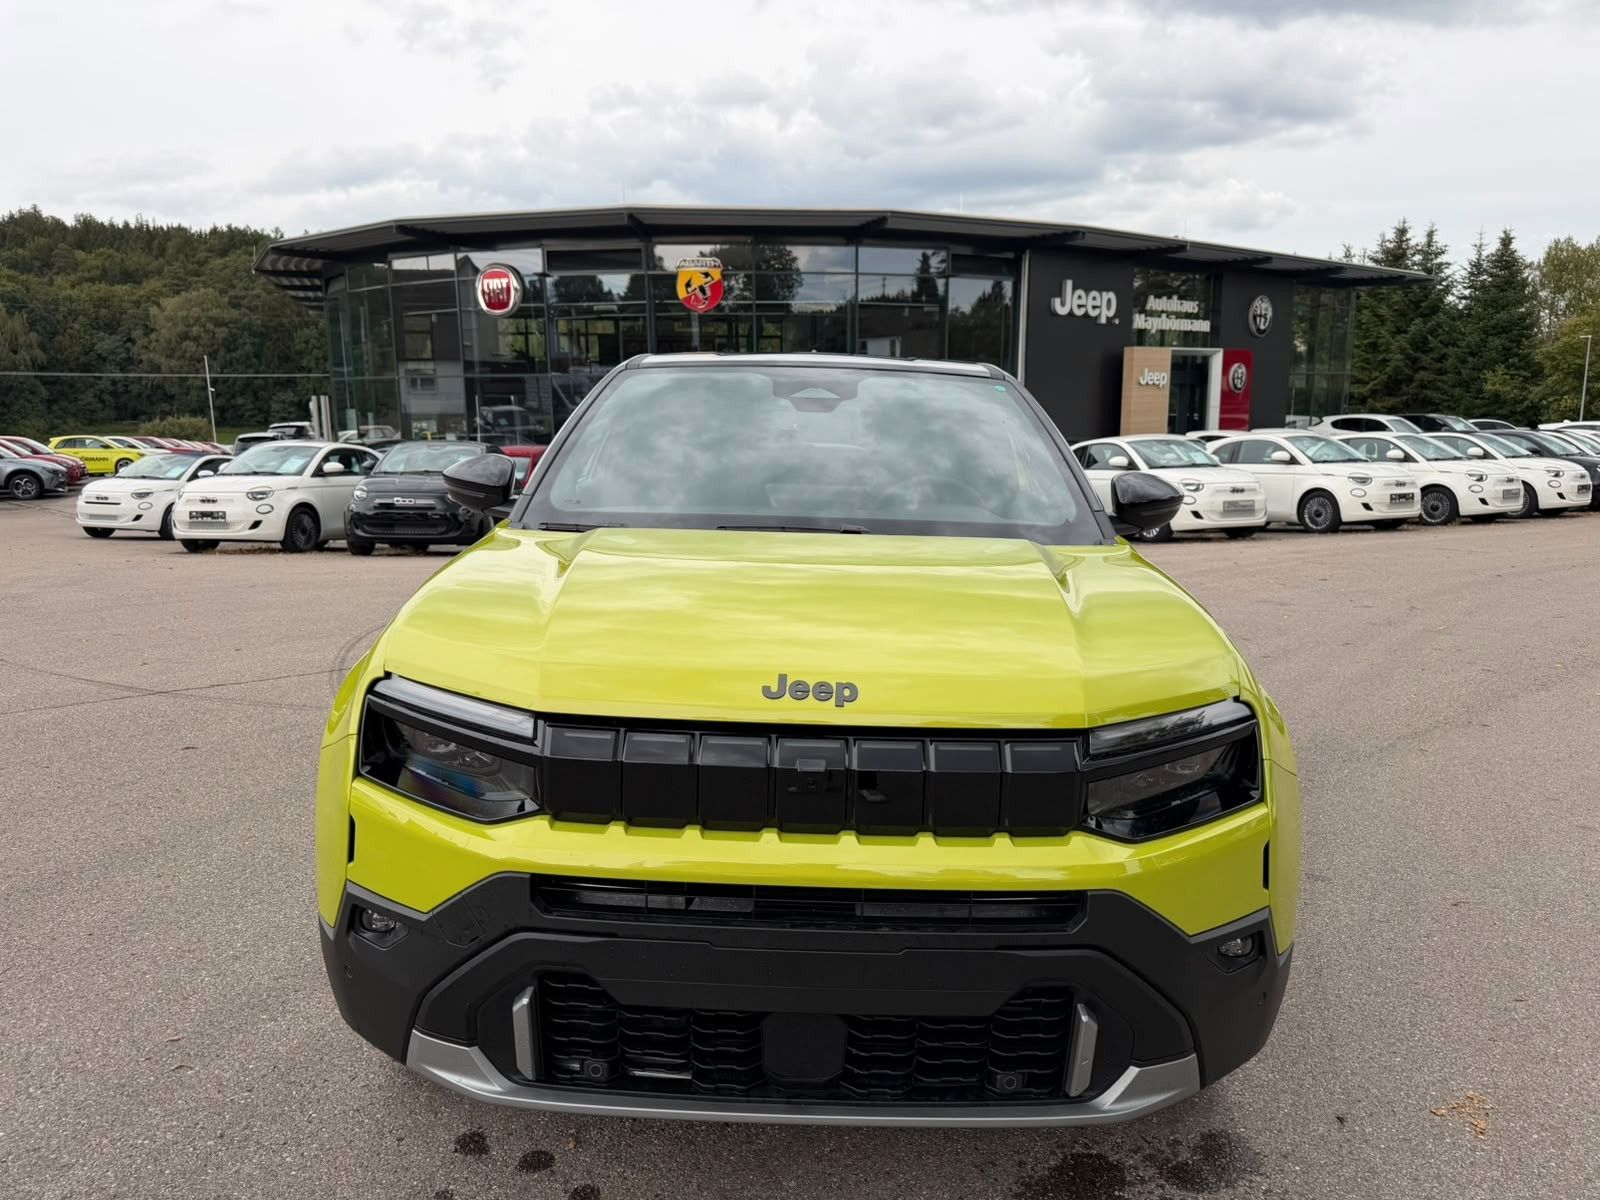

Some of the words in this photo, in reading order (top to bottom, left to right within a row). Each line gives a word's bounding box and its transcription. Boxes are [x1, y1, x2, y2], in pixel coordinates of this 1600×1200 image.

[482, 277, 509, 303] FIAT
[1051, 279, 1117, 324] Jeep
[1145, 294, 1199, 313] Autohaus
[1132, 313, 1211, 333] Mayrhörmann
[1138, 367, 1168, 388] Jeep
[762, 673, 859, 707] Jeep
